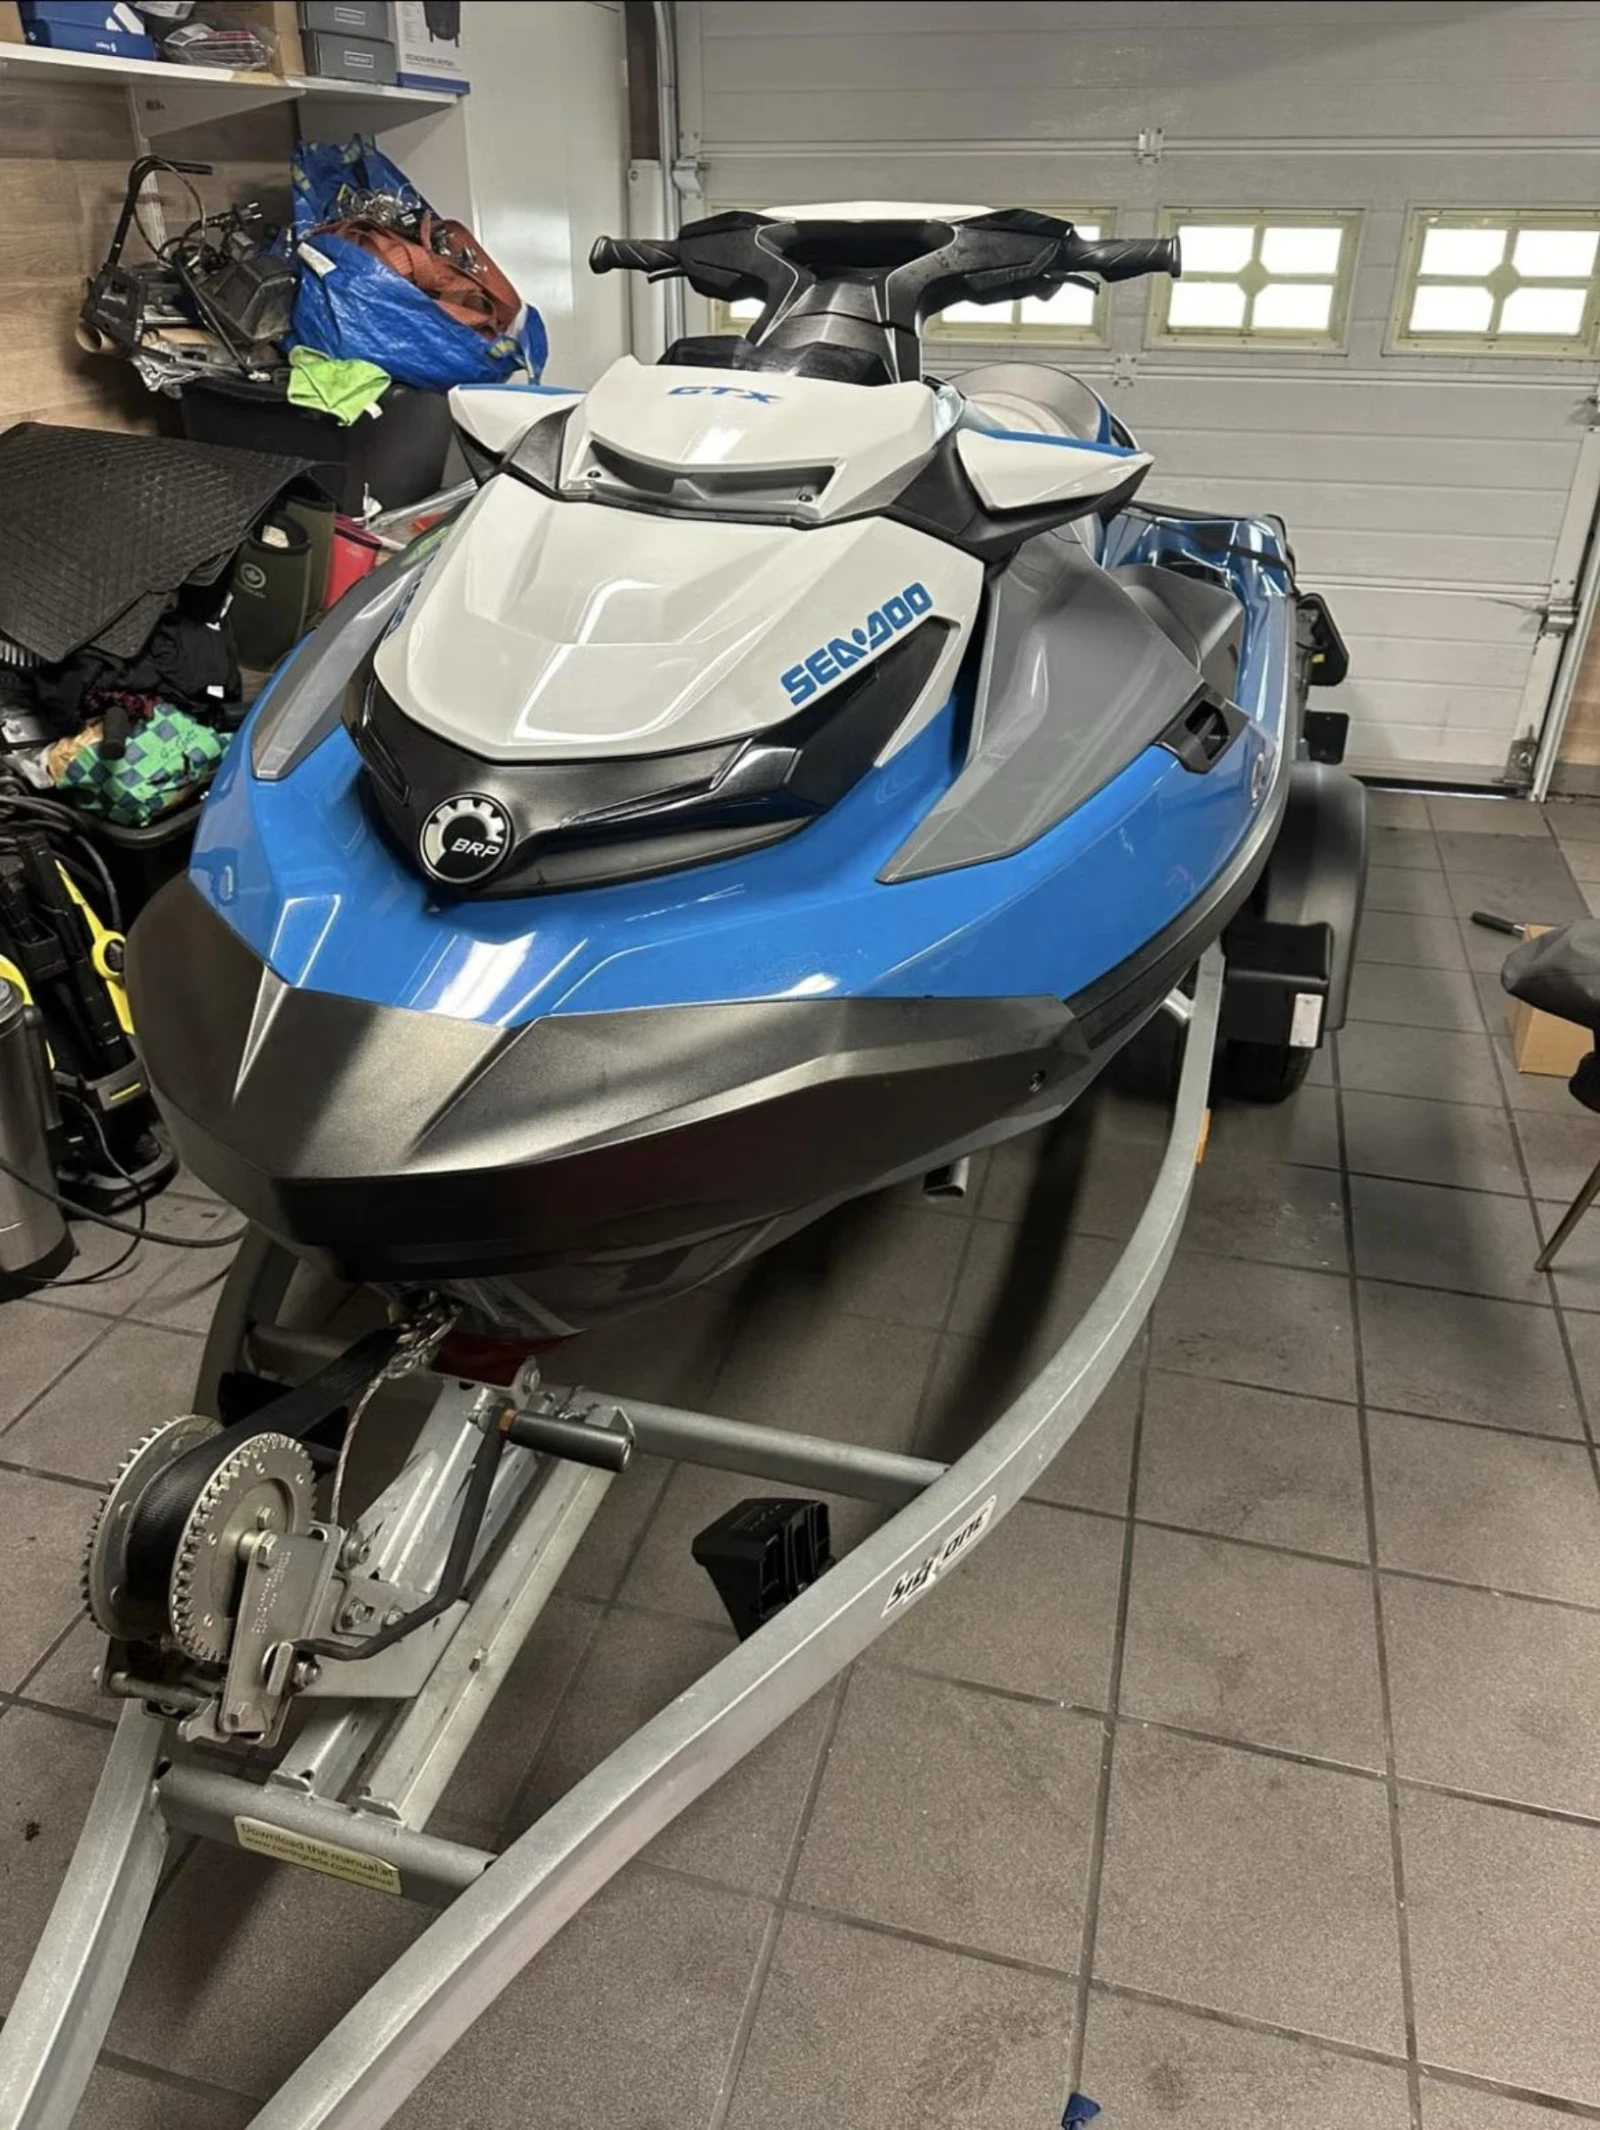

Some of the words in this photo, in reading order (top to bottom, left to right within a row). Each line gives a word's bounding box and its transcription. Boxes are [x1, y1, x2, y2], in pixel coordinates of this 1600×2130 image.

[667, 385, 783, 404] GTX
[450, 837, 500, 858] BRP
[241, 1822, 304, 1850] Download
[307, 1844, 328, 1858] the
[331, 1852, 378, 1874] manual
